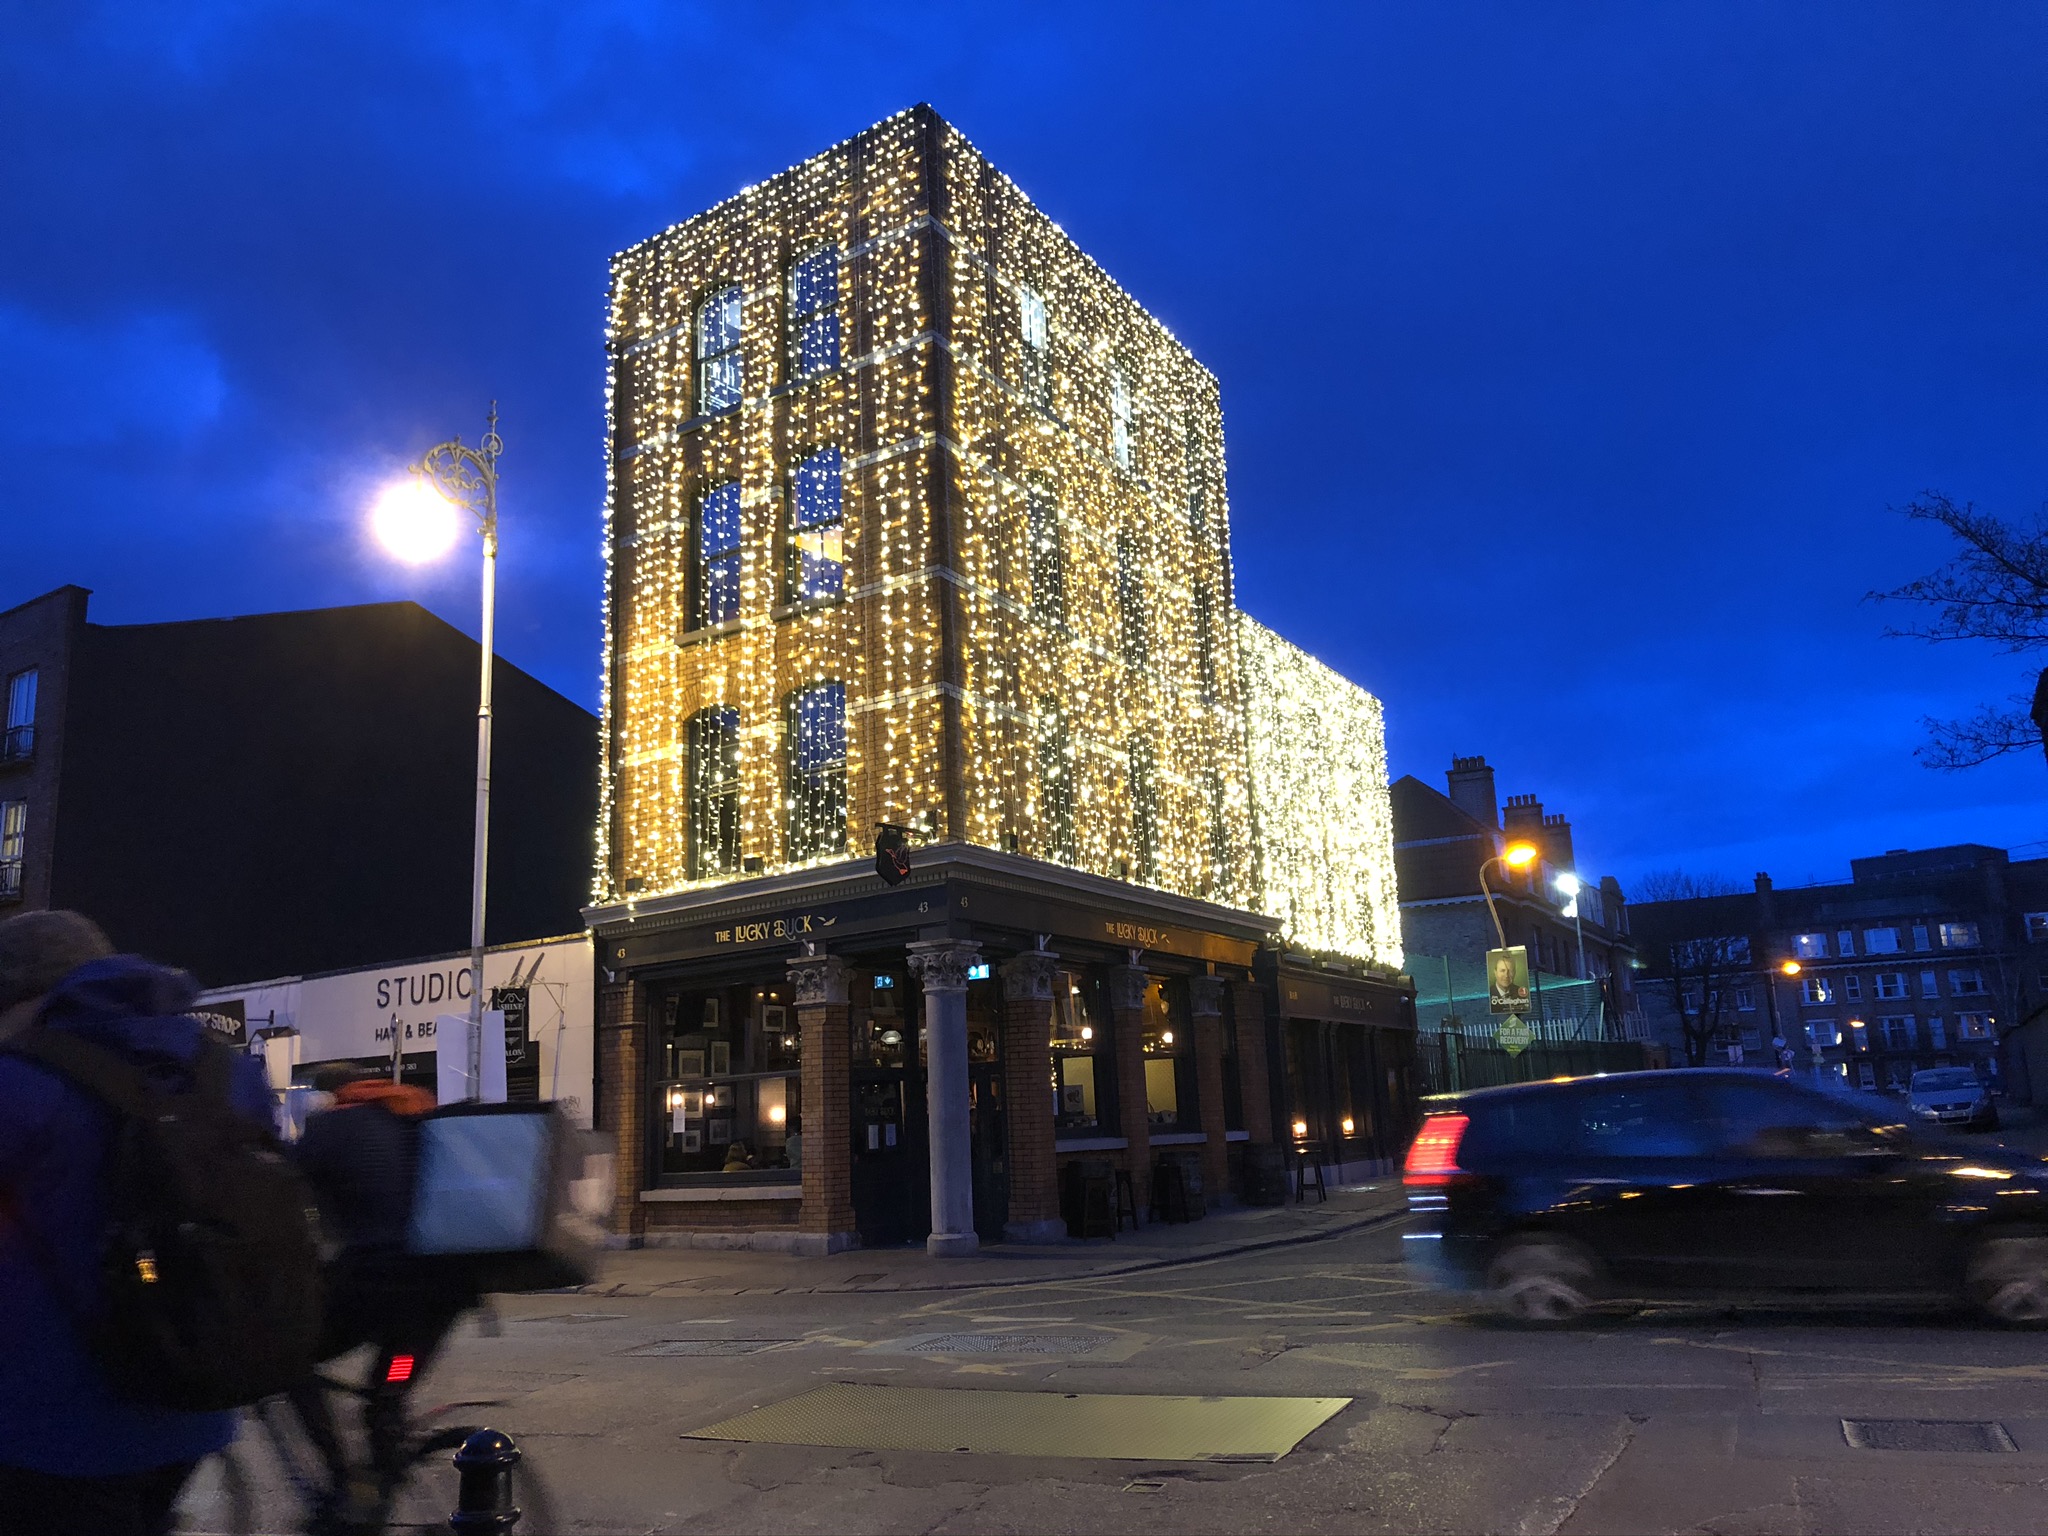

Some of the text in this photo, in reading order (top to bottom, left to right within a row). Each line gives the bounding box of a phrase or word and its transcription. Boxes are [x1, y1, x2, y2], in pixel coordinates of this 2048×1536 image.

[917, 901, 928, 913] 43
[960, 896, 968, 908] 43
[715, 915, 812, 943] THE LUCKY DUCK
[1105, 922, 1158, 948] THE LUCKY DUCK
[376, 967, 472, 1009] STUDIO
[211, 1013, 241, 1035] SHOP
[375, 1026, 397, 1041] HA
[405, 1024, 413, 1039] &
[1500, 1028, 1529, 1036] FOR A FAIR
[1500, 1036, 1529, 1044] RECOVERY
[505, 1048, 522, 1057] ALON
